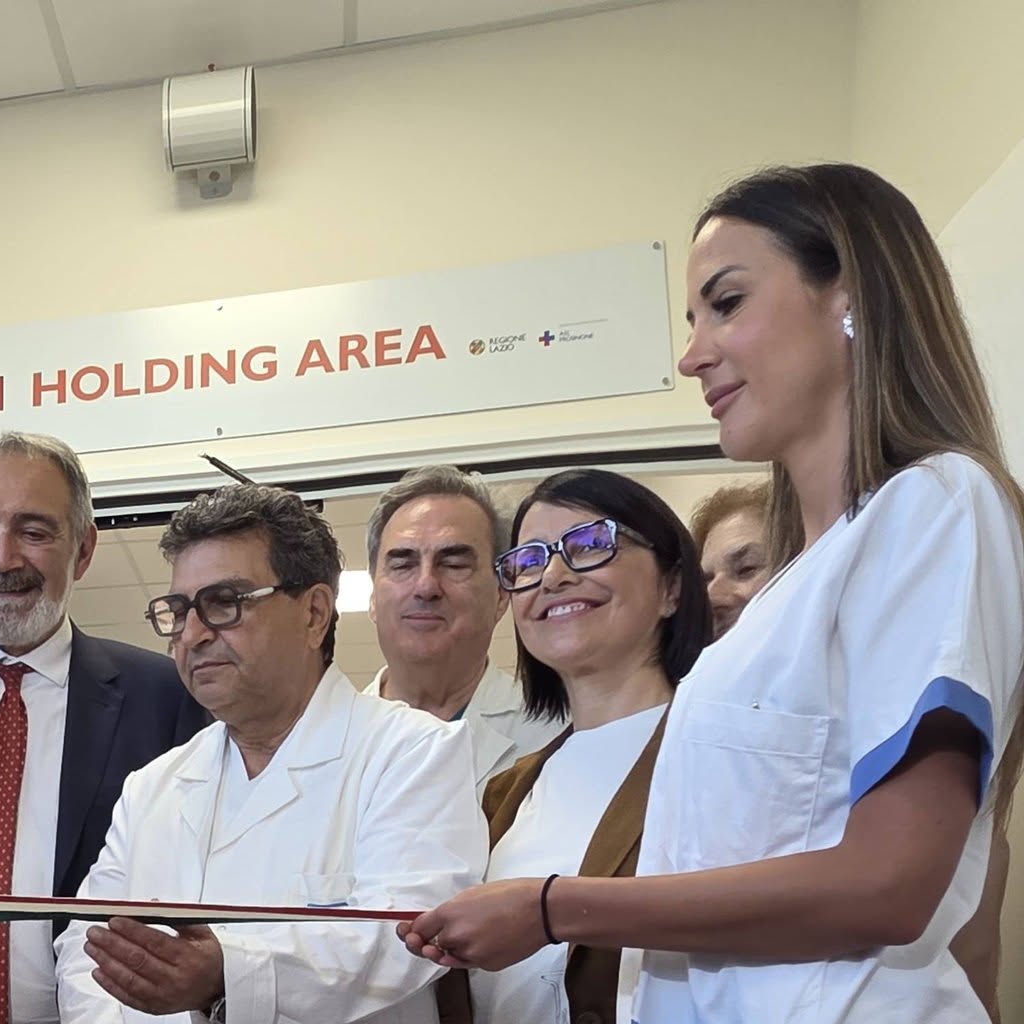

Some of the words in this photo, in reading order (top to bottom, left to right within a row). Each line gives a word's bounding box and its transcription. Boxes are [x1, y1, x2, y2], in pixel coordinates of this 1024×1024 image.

[489, 333, 526, 344] REGIONE
[489, 343, 515, 353] LAZIO
[32, 345, 277, 407] HOLDING
[295, 324, 447, 376] AREA
